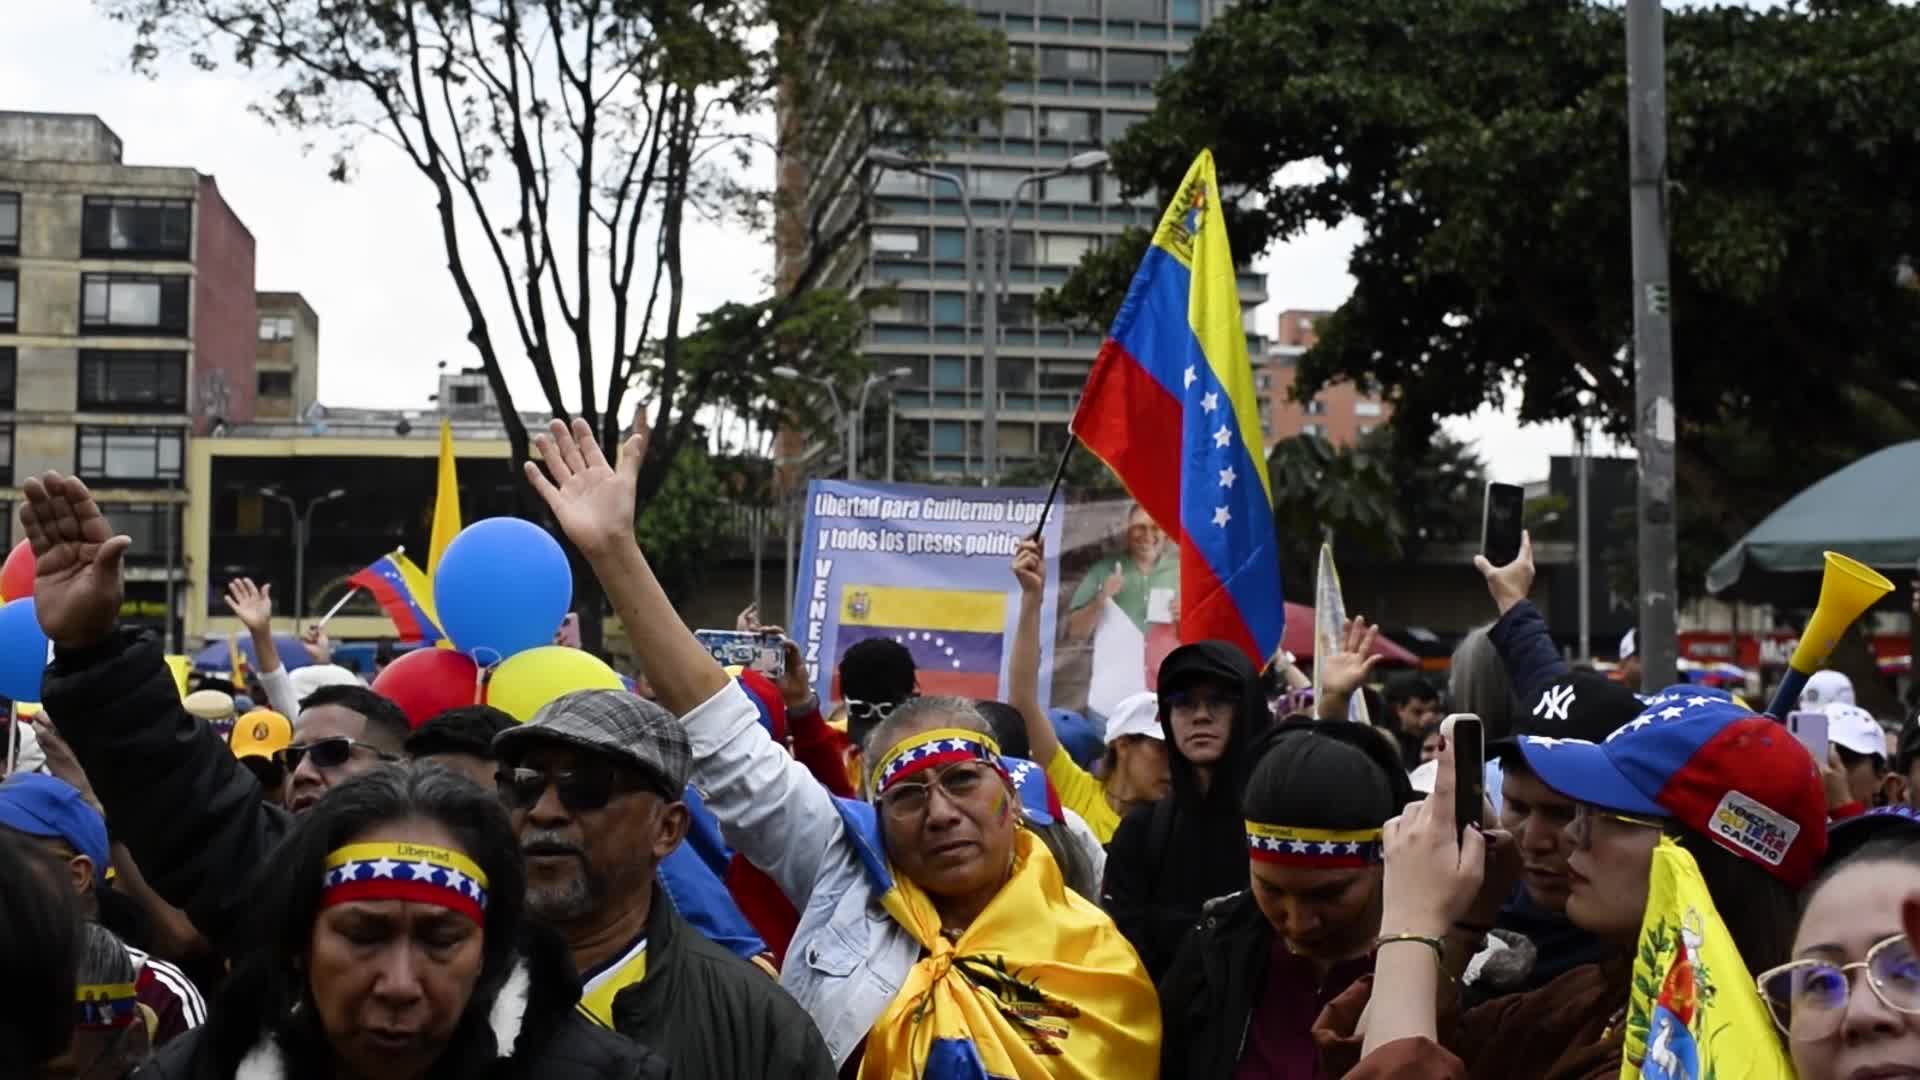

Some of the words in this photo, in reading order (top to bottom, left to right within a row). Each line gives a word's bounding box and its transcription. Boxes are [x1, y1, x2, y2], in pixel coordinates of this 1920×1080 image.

[815, 493, 881, 517] Libertad
[880, 499, 920, 521] para
[922, 497, 1004, 521] Guillermo
[819, 528, 830, 550] y
[831, 528, 878, 550] todos
[880, 528, 905, 551] los
[907, 532, 963, 554] presos
[965, 532, 1020, 555] polític
[805, 559, 832, 693] VENEZU
[397, 844, 449, 861] Libertad
[1721, 824, 1778, 860] CAMBIO
